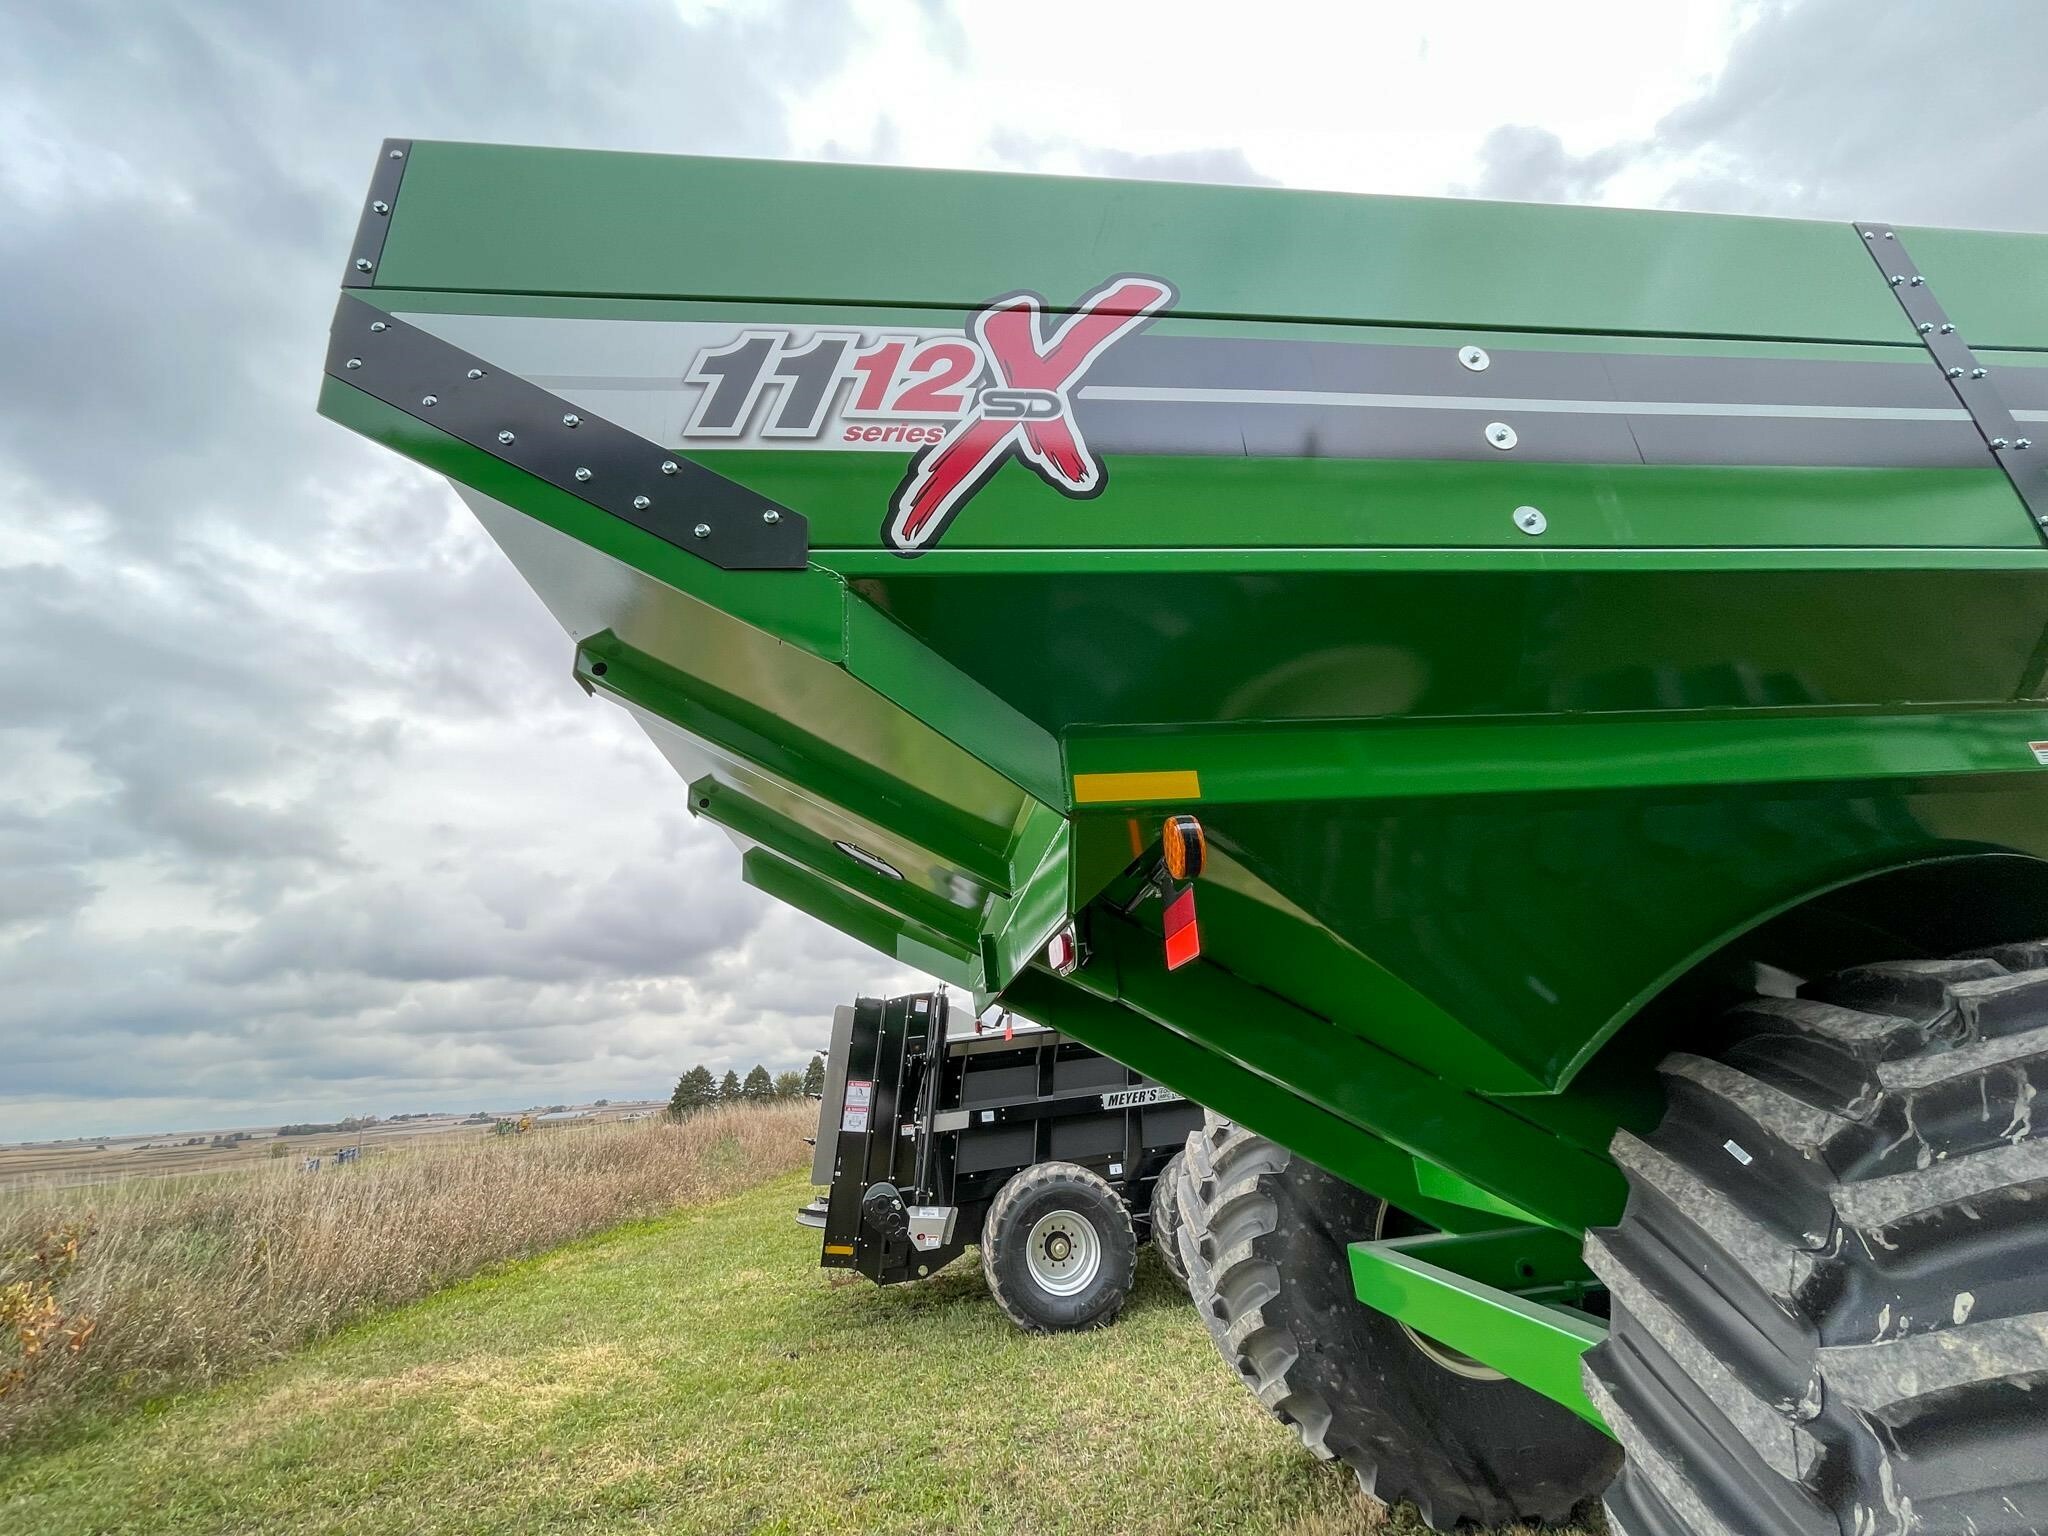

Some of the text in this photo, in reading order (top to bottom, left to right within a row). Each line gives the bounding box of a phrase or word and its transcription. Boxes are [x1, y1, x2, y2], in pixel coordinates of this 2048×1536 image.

[981, 391, 1061, 418] SD
[842, 423, 945, 443] series
[1107, 1089, 1157, 1107] MEYER'S
